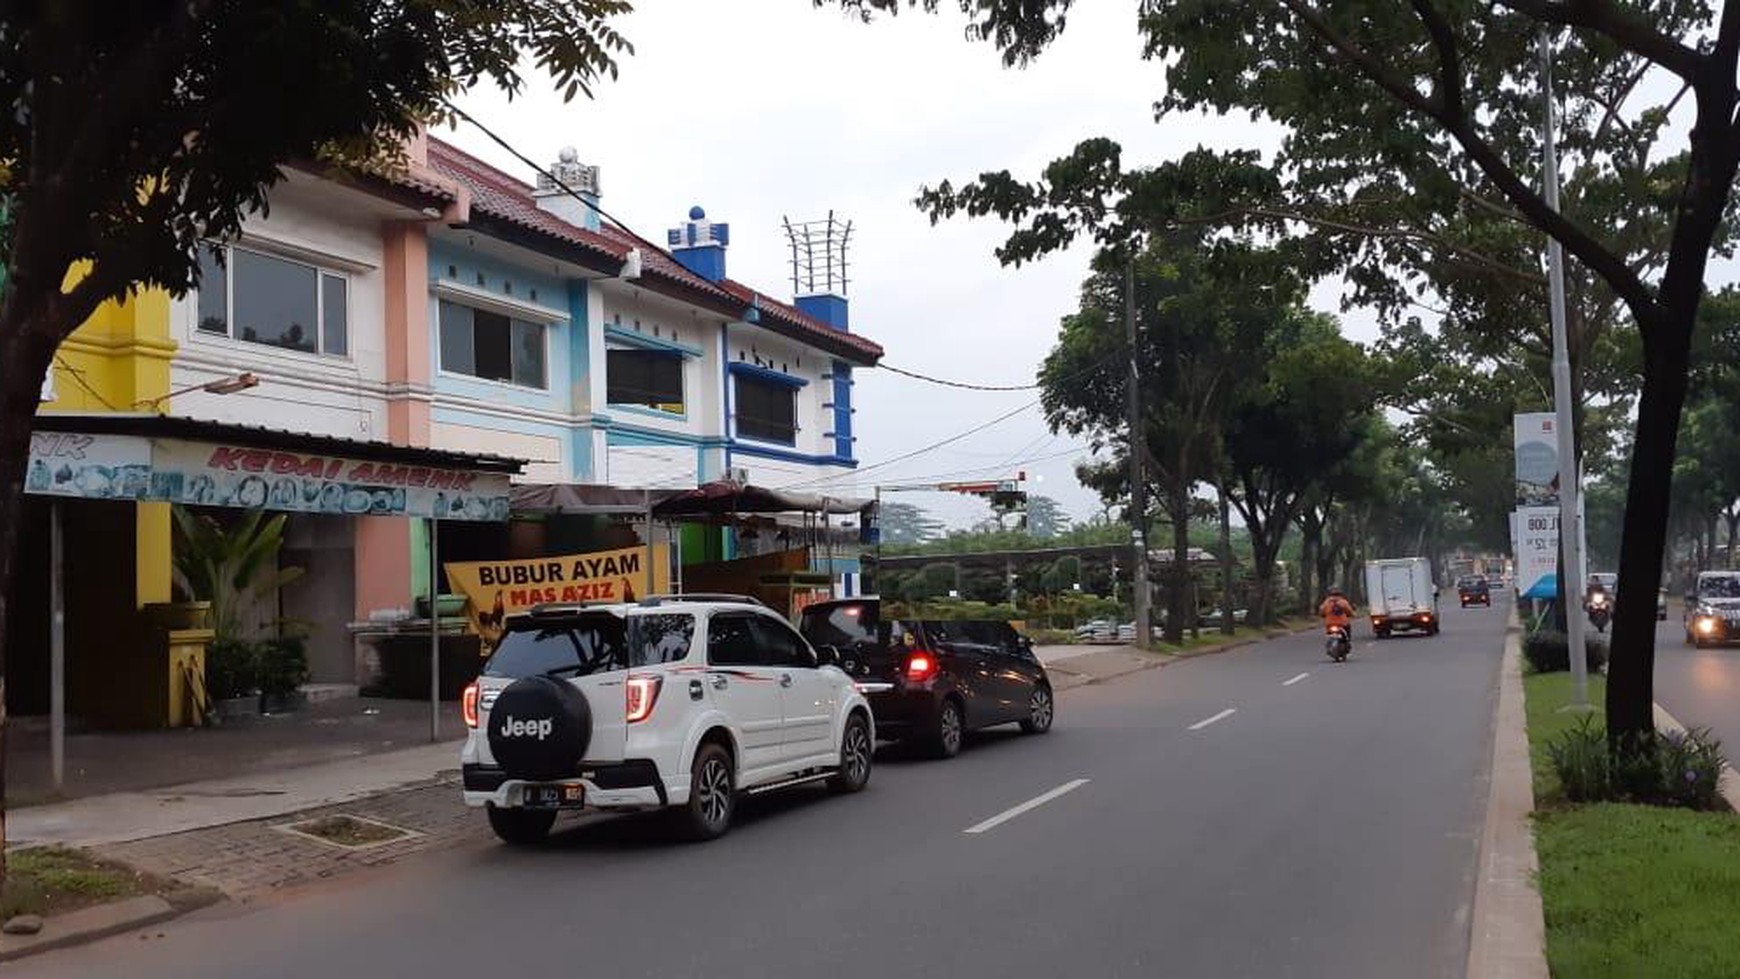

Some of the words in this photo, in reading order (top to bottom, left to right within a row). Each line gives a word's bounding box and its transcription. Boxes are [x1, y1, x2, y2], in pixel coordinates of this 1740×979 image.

[208, 447, 344, 479] KEDAI
[349, 462, 476, 492] AMENK
[479, 564, 563, 587] BUBUR
[572, 553, 639, 580] AYAM
[510, 587, 556, 606] MAS
[562, 582, 614, 602] AZIZ
[502, 716, 552, 740] Jeep
